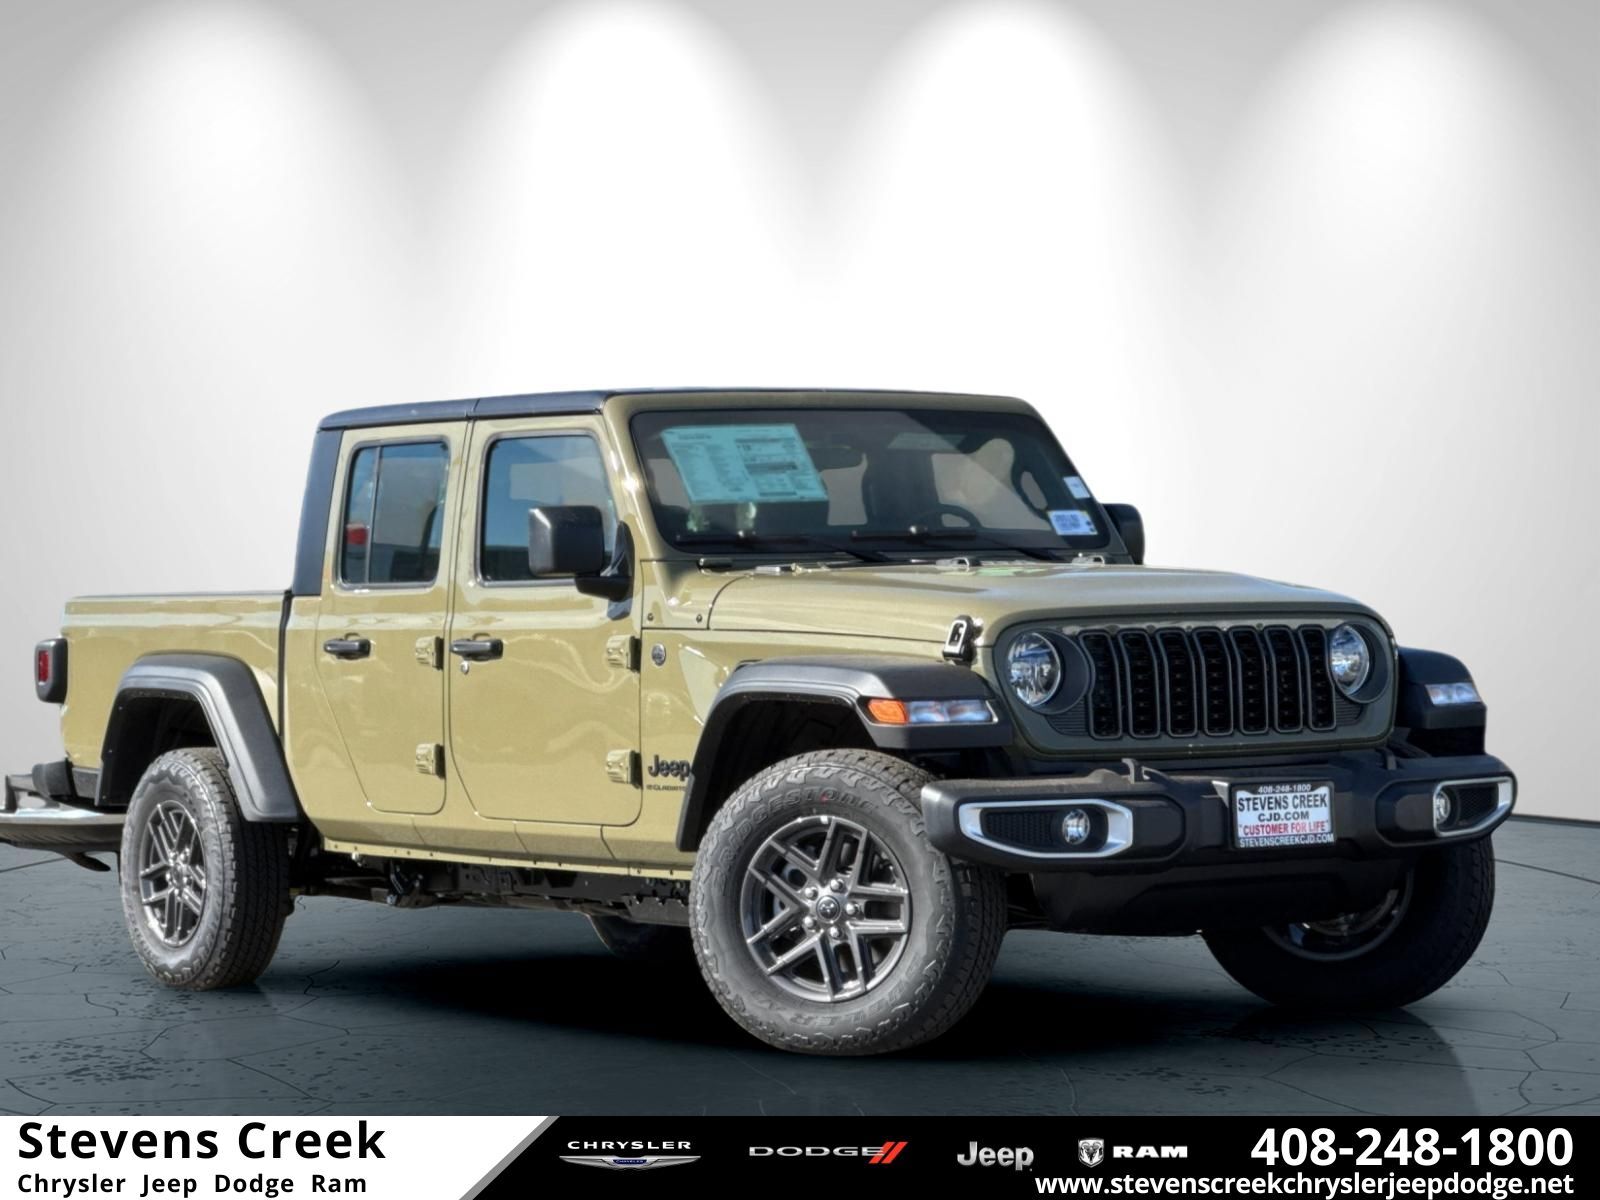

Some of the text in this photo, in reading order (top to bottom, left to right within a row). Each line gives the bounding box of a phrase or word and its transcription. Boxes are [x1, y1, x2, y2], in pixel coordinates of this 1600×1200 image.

[647, 754, 690, 782] Jeep
[1258, 784, 1311, 794] 408-248-1800
[1238, 794, 1327, 811] STEVENS CREEK
[1258, 811, 1309, 822] CJD.COM
[1291, 822, 1307, 833] FOR
[1240, 834, 1334, 847] STEVENSCREEKCJD.COM
